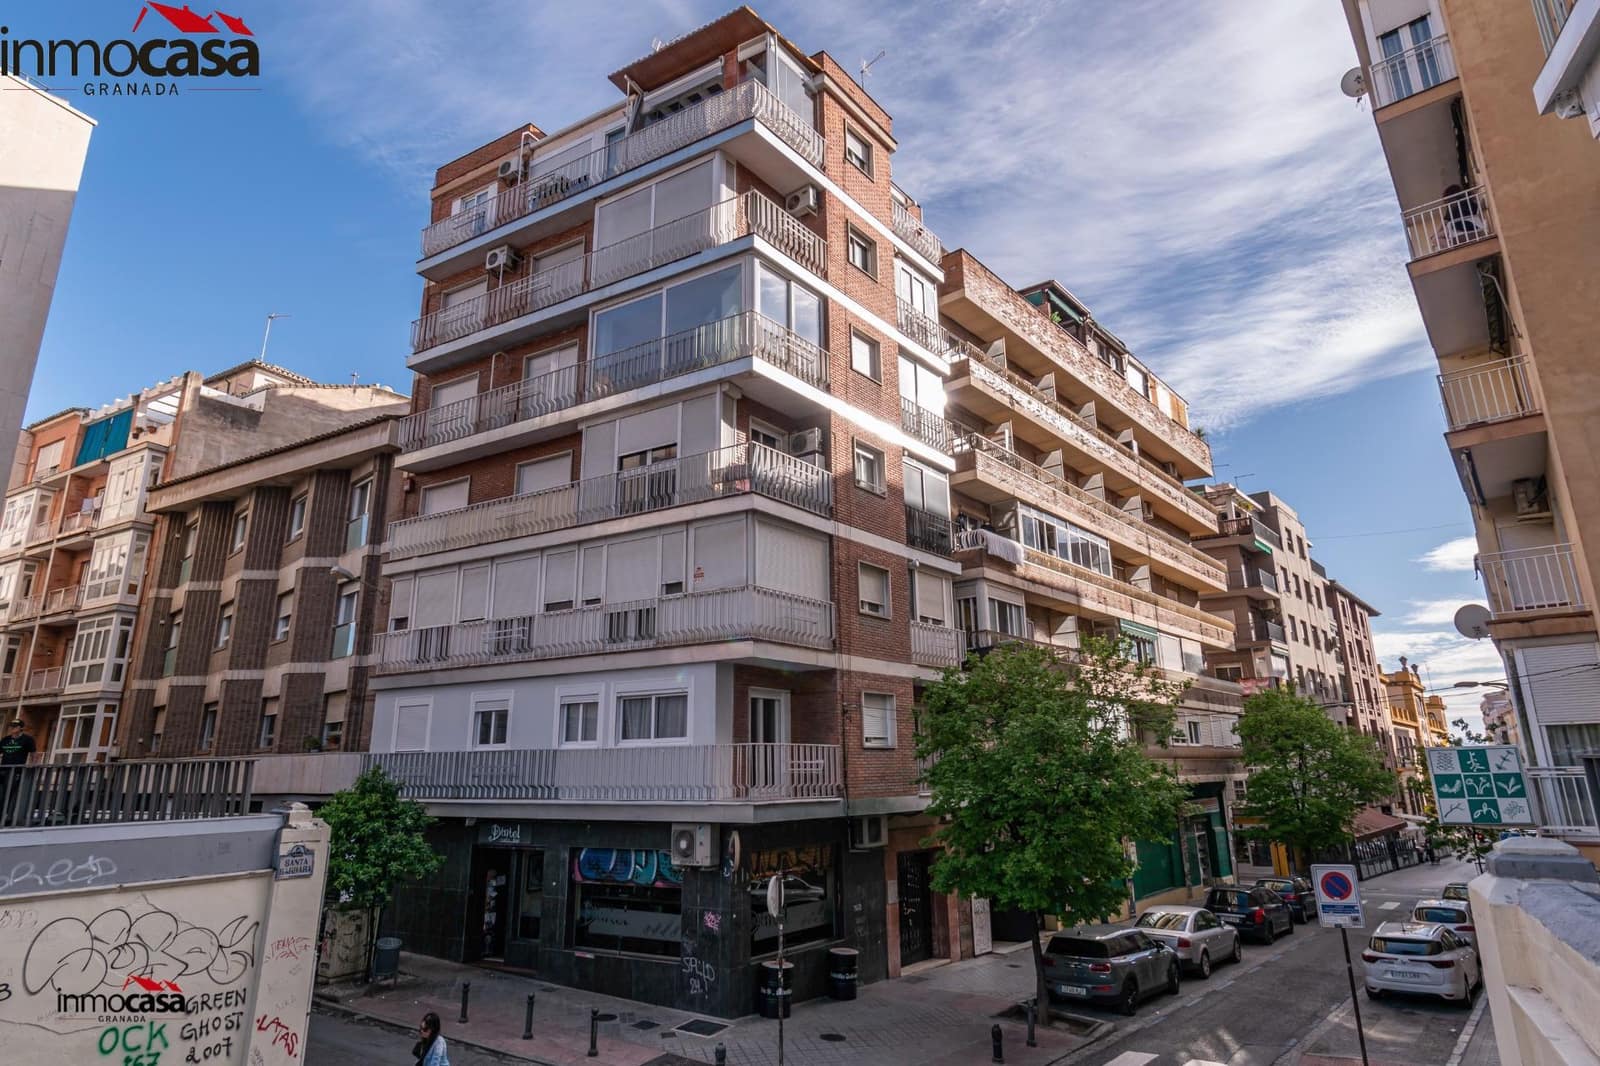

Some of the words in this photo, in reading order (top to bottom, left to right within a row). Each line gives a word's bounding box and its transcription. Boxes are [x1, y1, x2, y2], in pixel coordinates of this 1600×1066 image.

[185, 987, 247, 1015] GREEN
[97, 1020, 169, 1055] OCK
[180, 1011, 244, 1041] GHOST
[185, 1036, 232, 1064] 2007
